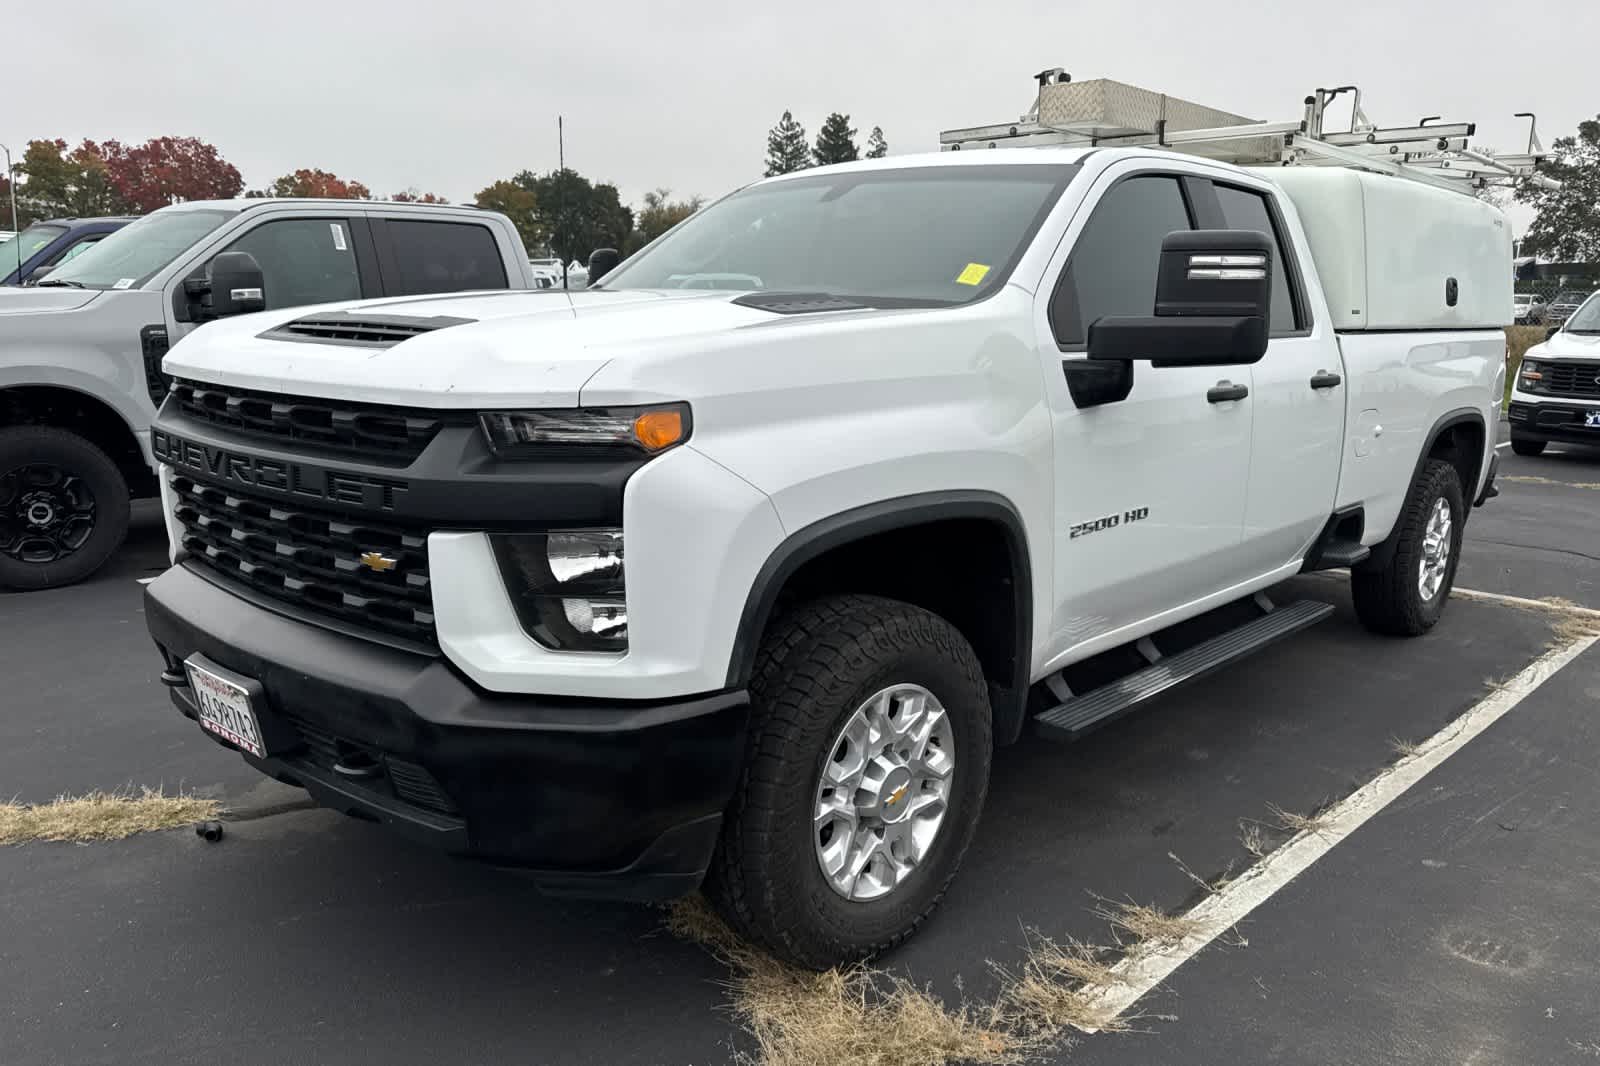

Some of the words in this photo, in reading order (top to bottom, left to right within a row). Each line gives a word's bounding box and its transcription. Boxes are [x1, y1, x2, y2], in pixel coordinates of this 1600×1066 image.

[151, 429, 409, 510] CHEVROLET
[1070, 515, 1119, 539] 2500
[1124, 507, 1149, 523] HD
